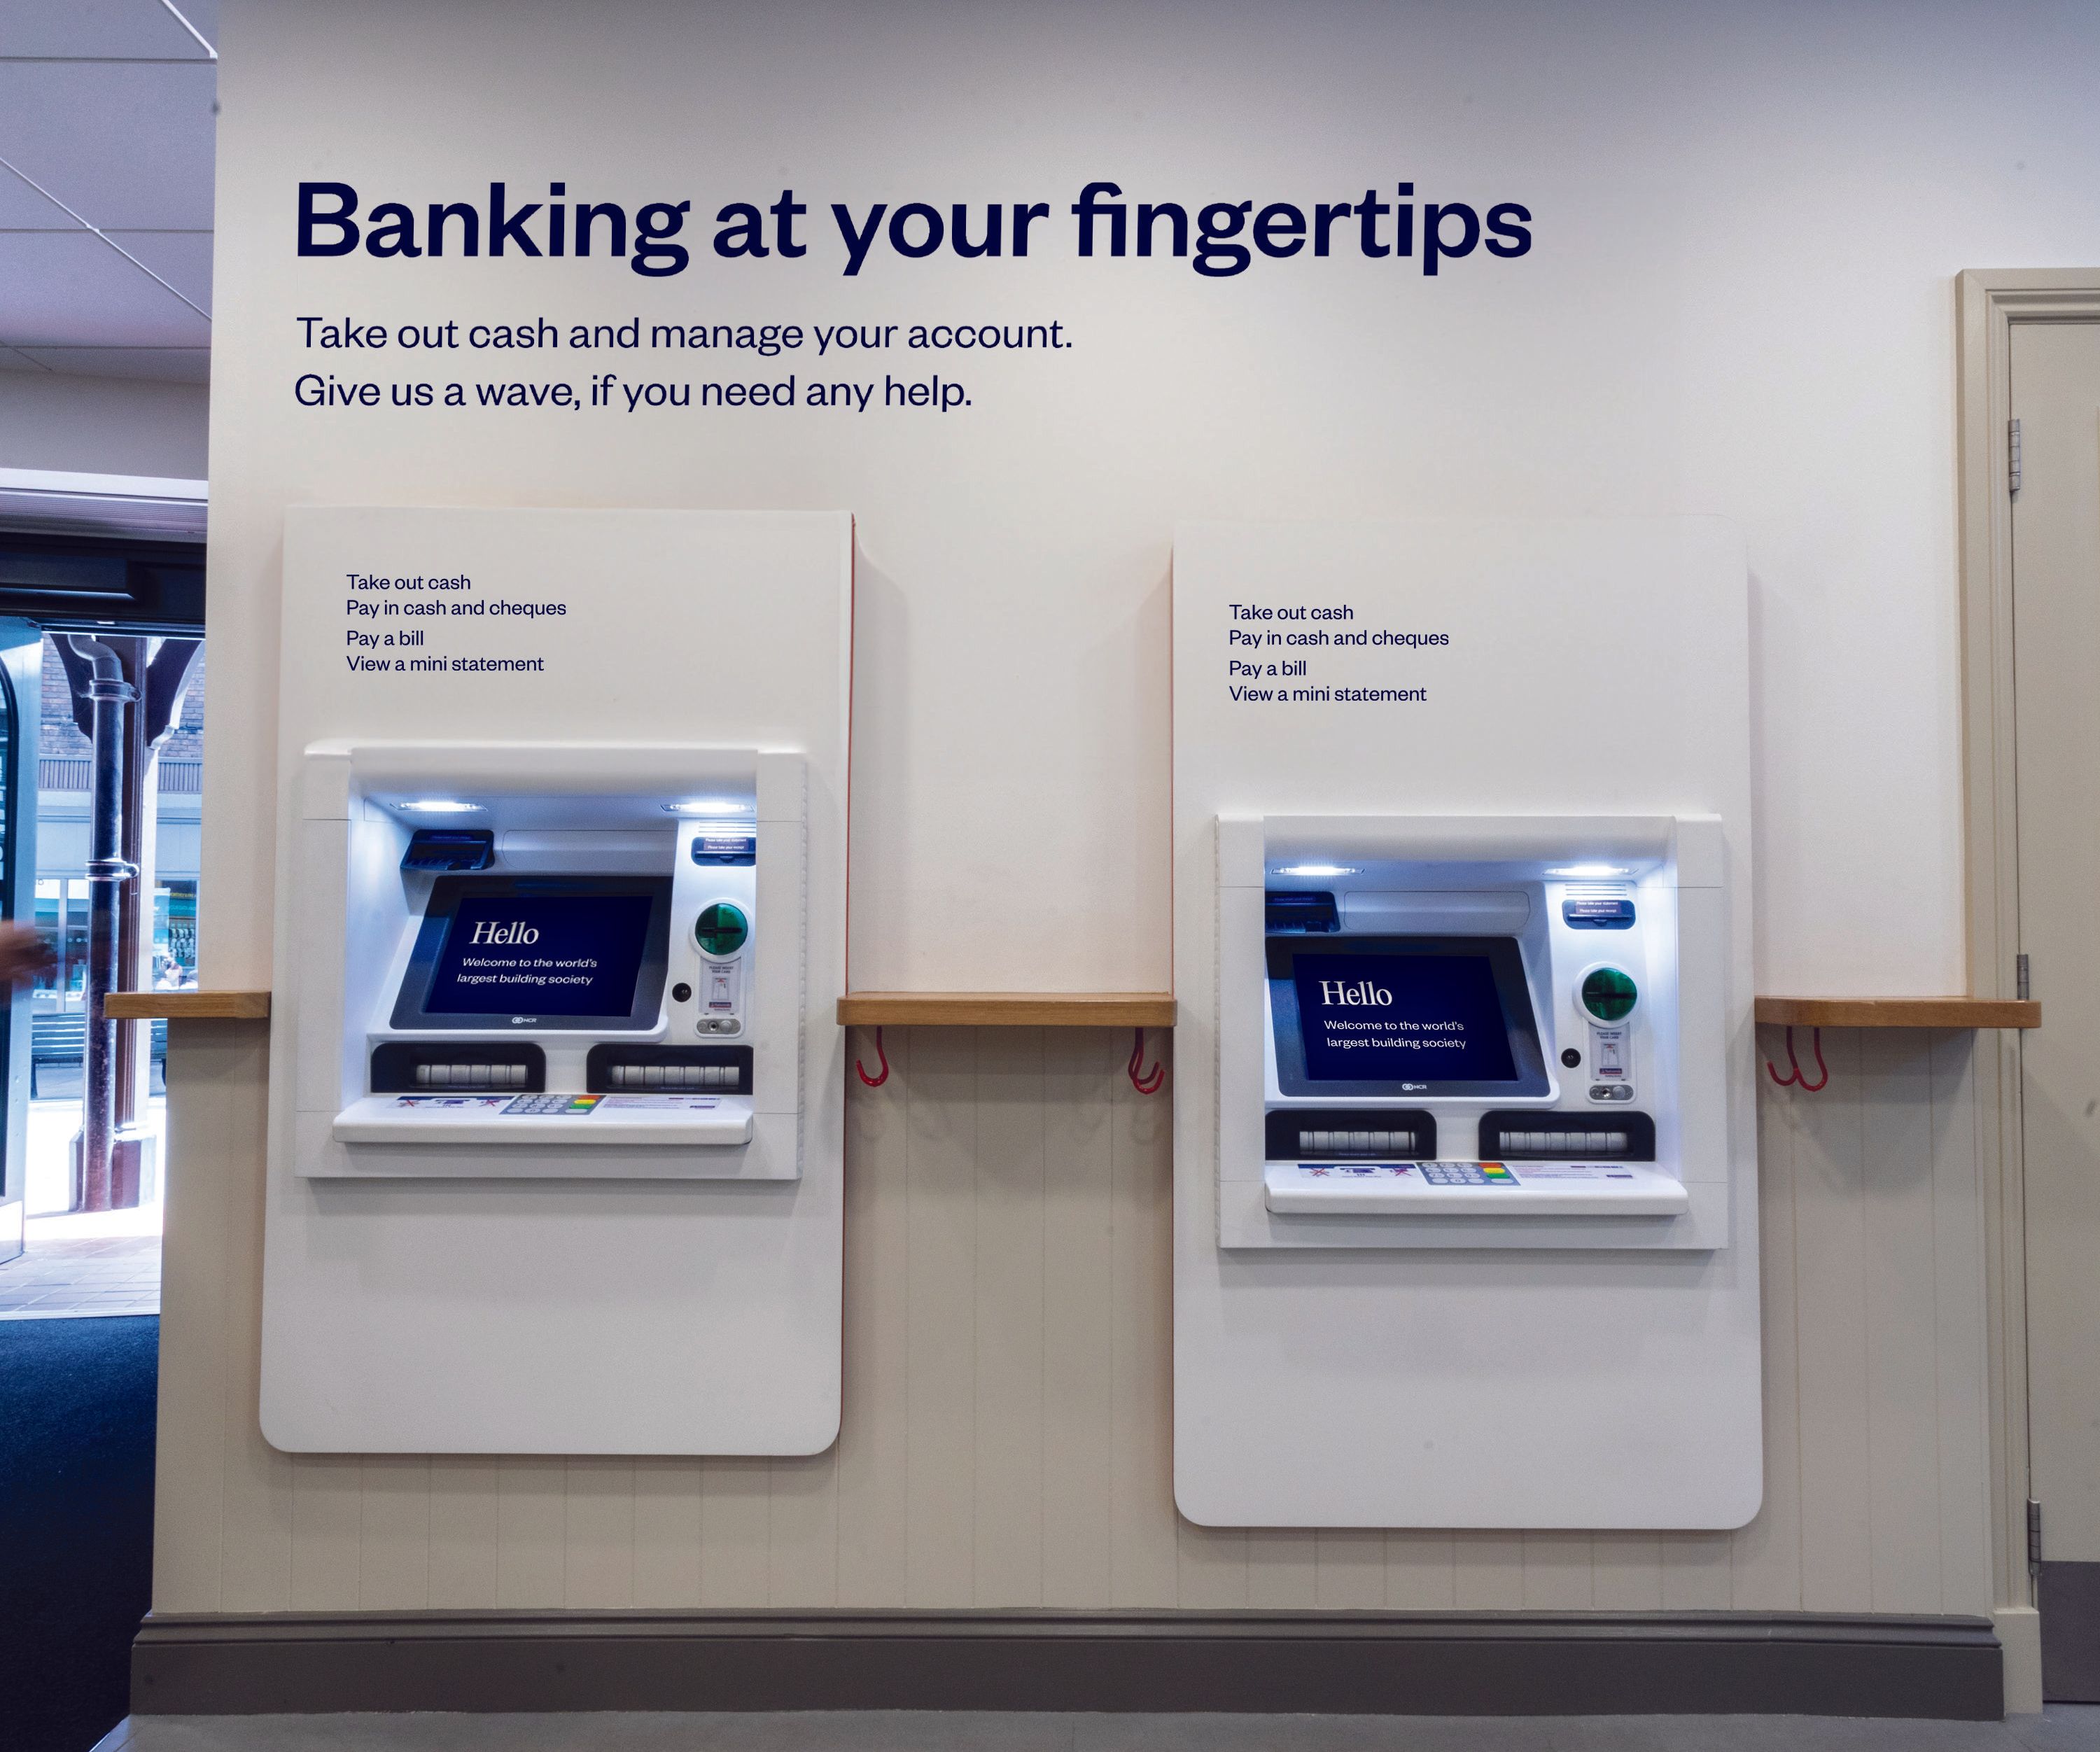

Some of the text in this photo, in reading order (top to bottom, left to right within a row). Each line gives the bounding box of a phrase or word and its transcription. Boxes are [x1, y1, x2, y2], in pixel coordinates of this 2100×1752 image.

[296, 181, 1533, 278] Banking at your fingertips
[295, 316, 1072, 358] Take out cash and manage your account.
[294, 372, 972, 414] Give us a wave, if you need any help.
[346, 574, 471, 590] Take out cash
[346, 599, 566, 619] Pay in cash and cheques
[1228, 604, 1354, 620] Take out cash
[346, 630, 424, 650] Pay a bill
[1229, 629, 1449, 650] Pay in cash and cheques
[346, 655, 545, 671] View a mini statement
[1229, 660, 1306, 680] Pay a bill
[1228, 685, 1427, 701] View a mini statement
[468, 921, 540, 945] Hello
[462, 958, 598, 968] Welcome to the world's
[456, 973, 594, 986] largest building society
[1318, 981, 1393, 1006] Hello
[1324, 1020, 1464, 1030] Welcome to the world's
[1326, 1037, 1466, 1050] largest building society
